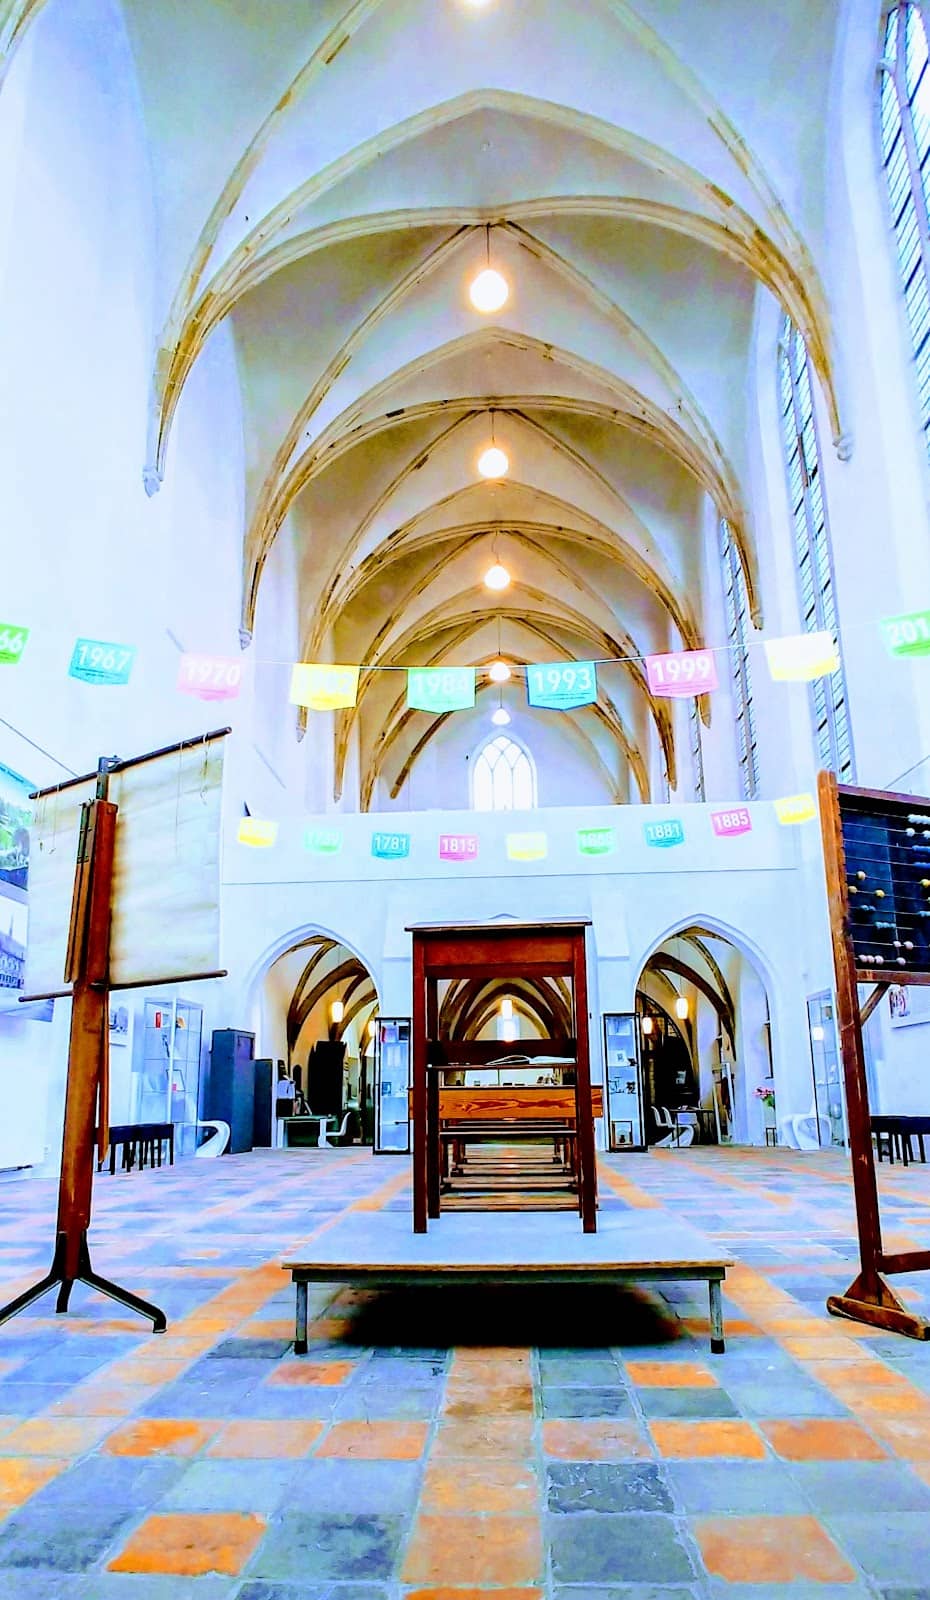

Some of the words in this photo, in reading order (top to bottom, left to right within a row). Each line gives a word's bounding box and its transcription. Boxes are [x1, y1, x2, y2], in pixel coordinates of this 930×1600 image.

[77, 645, 134, 672] 1967
[184, 660, 241, 687] 1970
[651, 655, 710, 683] 1999
[532, 668, 591, 692] 1993
[714, 812, 749, 829] 1885
[647, 824, 682, 840] 1881
[373, 836, 406, 850] 1781
[442, 838, 476, 852] 1815
